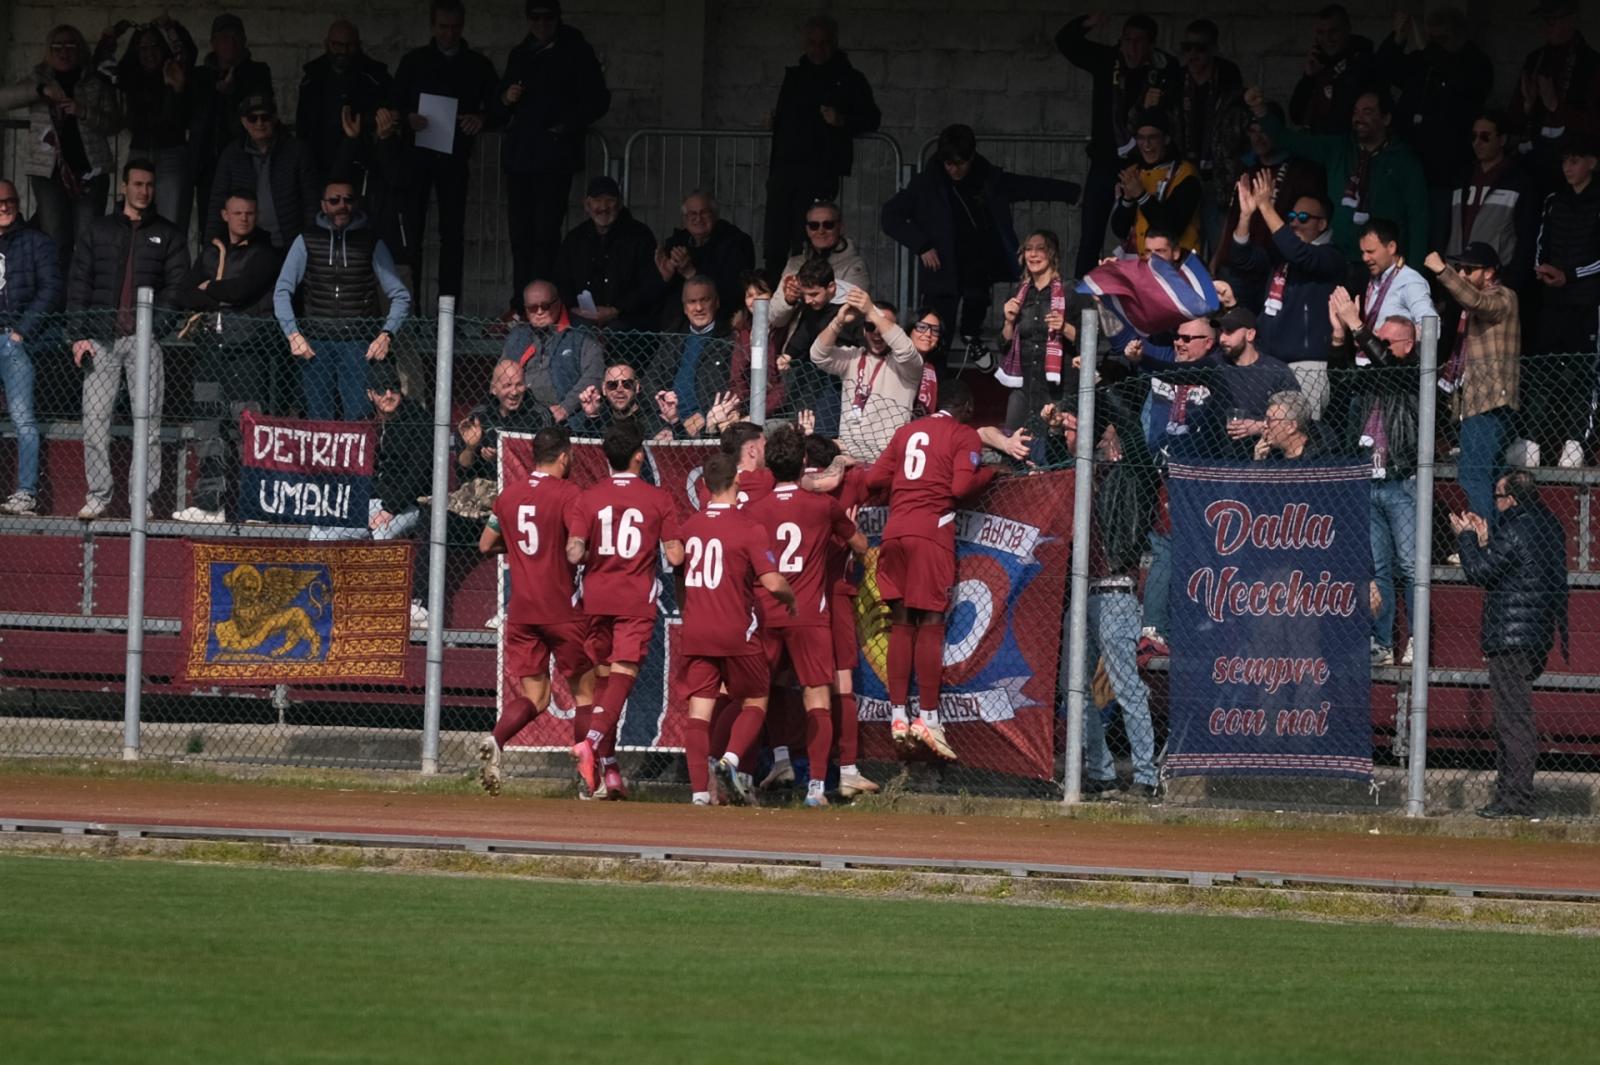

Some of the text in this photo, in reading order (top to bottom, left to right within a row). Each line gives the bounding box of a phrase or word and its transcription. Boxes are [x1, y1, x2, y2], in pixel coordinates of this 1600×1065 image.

[253, 424, 367, 468] DETRITI
[903, 431, 930, 480] 6
[259, 479, 351, 519] UMANI
[517, 504, 539, 556] 5
[597, 505, 644, 559] 16
[776, 521, 804, 573] 2
[1204, 499, 1336, 556] Dalla
[684, 536, 724, 590] 20
[1187, 566, 1357, 623] Vecchia
[1212, 655, 1330, 694] sempre
[1209, 701, 1331, 737] con noi
